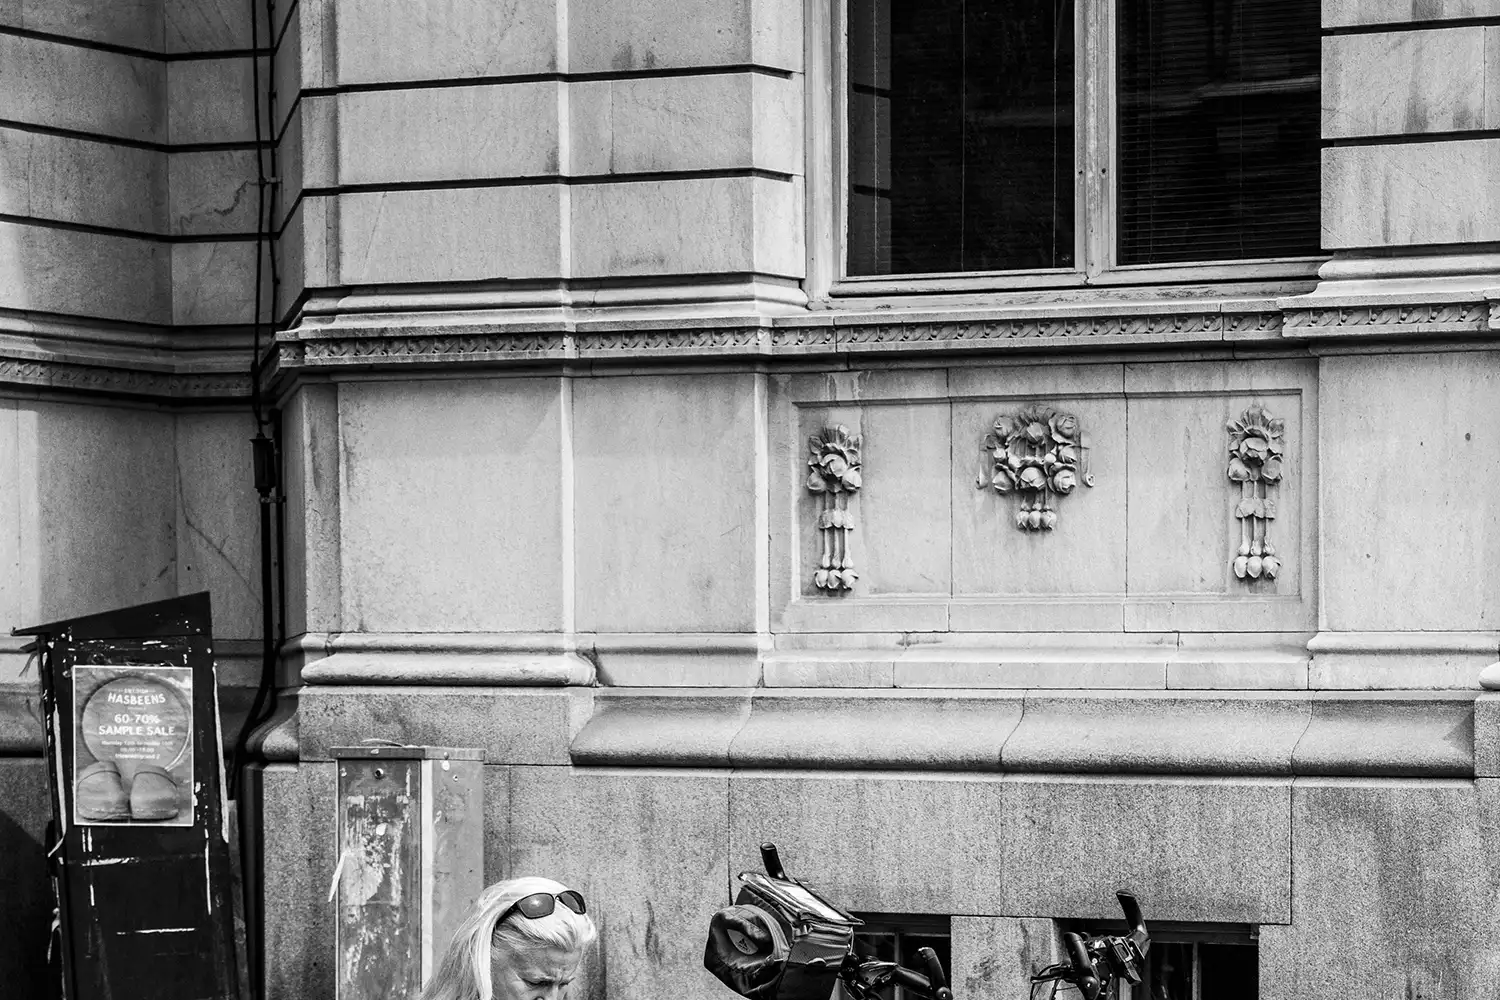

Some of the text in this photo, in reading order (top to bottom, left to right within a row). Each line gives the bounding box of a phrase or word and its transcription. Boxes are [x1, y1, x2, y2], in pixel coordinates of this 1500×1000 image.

[107, 691, 166, 705] HASBEENS
[98, 725, 176, 737] SAMPLE SALE
